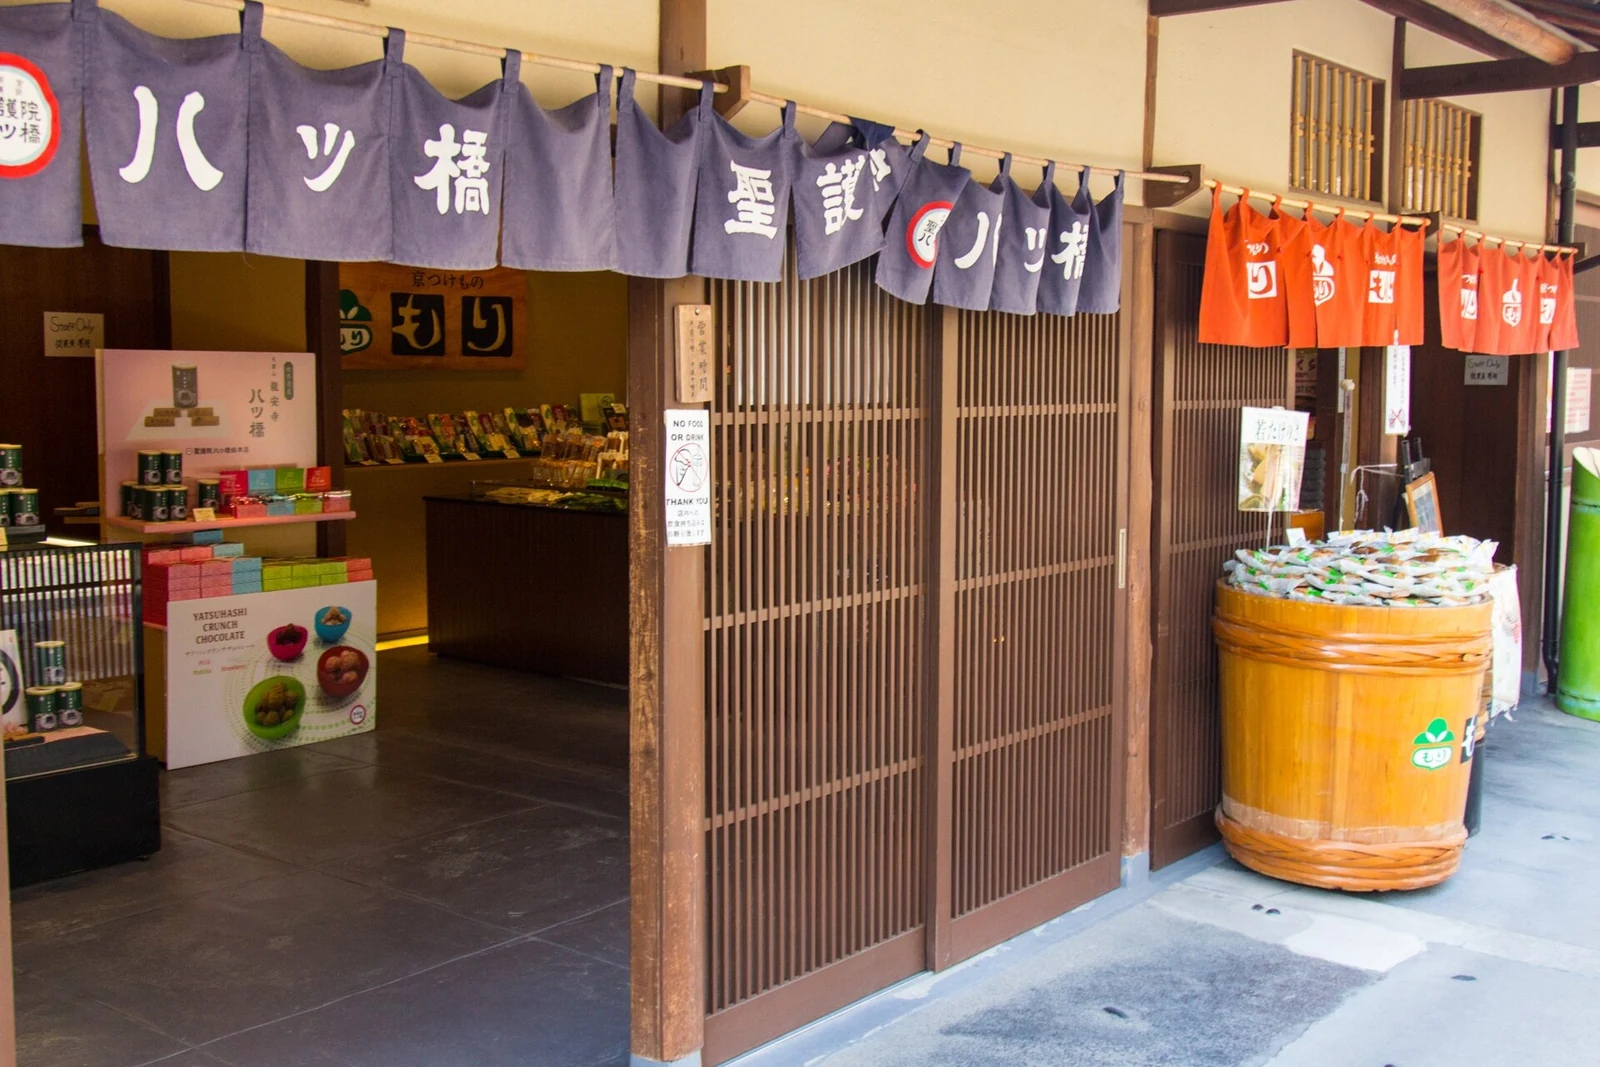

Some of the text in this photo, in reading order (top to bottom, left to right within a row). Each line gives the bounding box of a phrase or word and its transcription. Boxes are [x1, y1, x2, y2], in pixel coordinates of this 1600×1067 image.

[412, 271, 484, 289] 京つけもの
[392, 294, 507, 351] もり
[193, 608, 248, 621] YATSUHASHI
[202, 620, 238, 632] CRUNCH
[195, 631, 245, 644] CHOCOLATE
